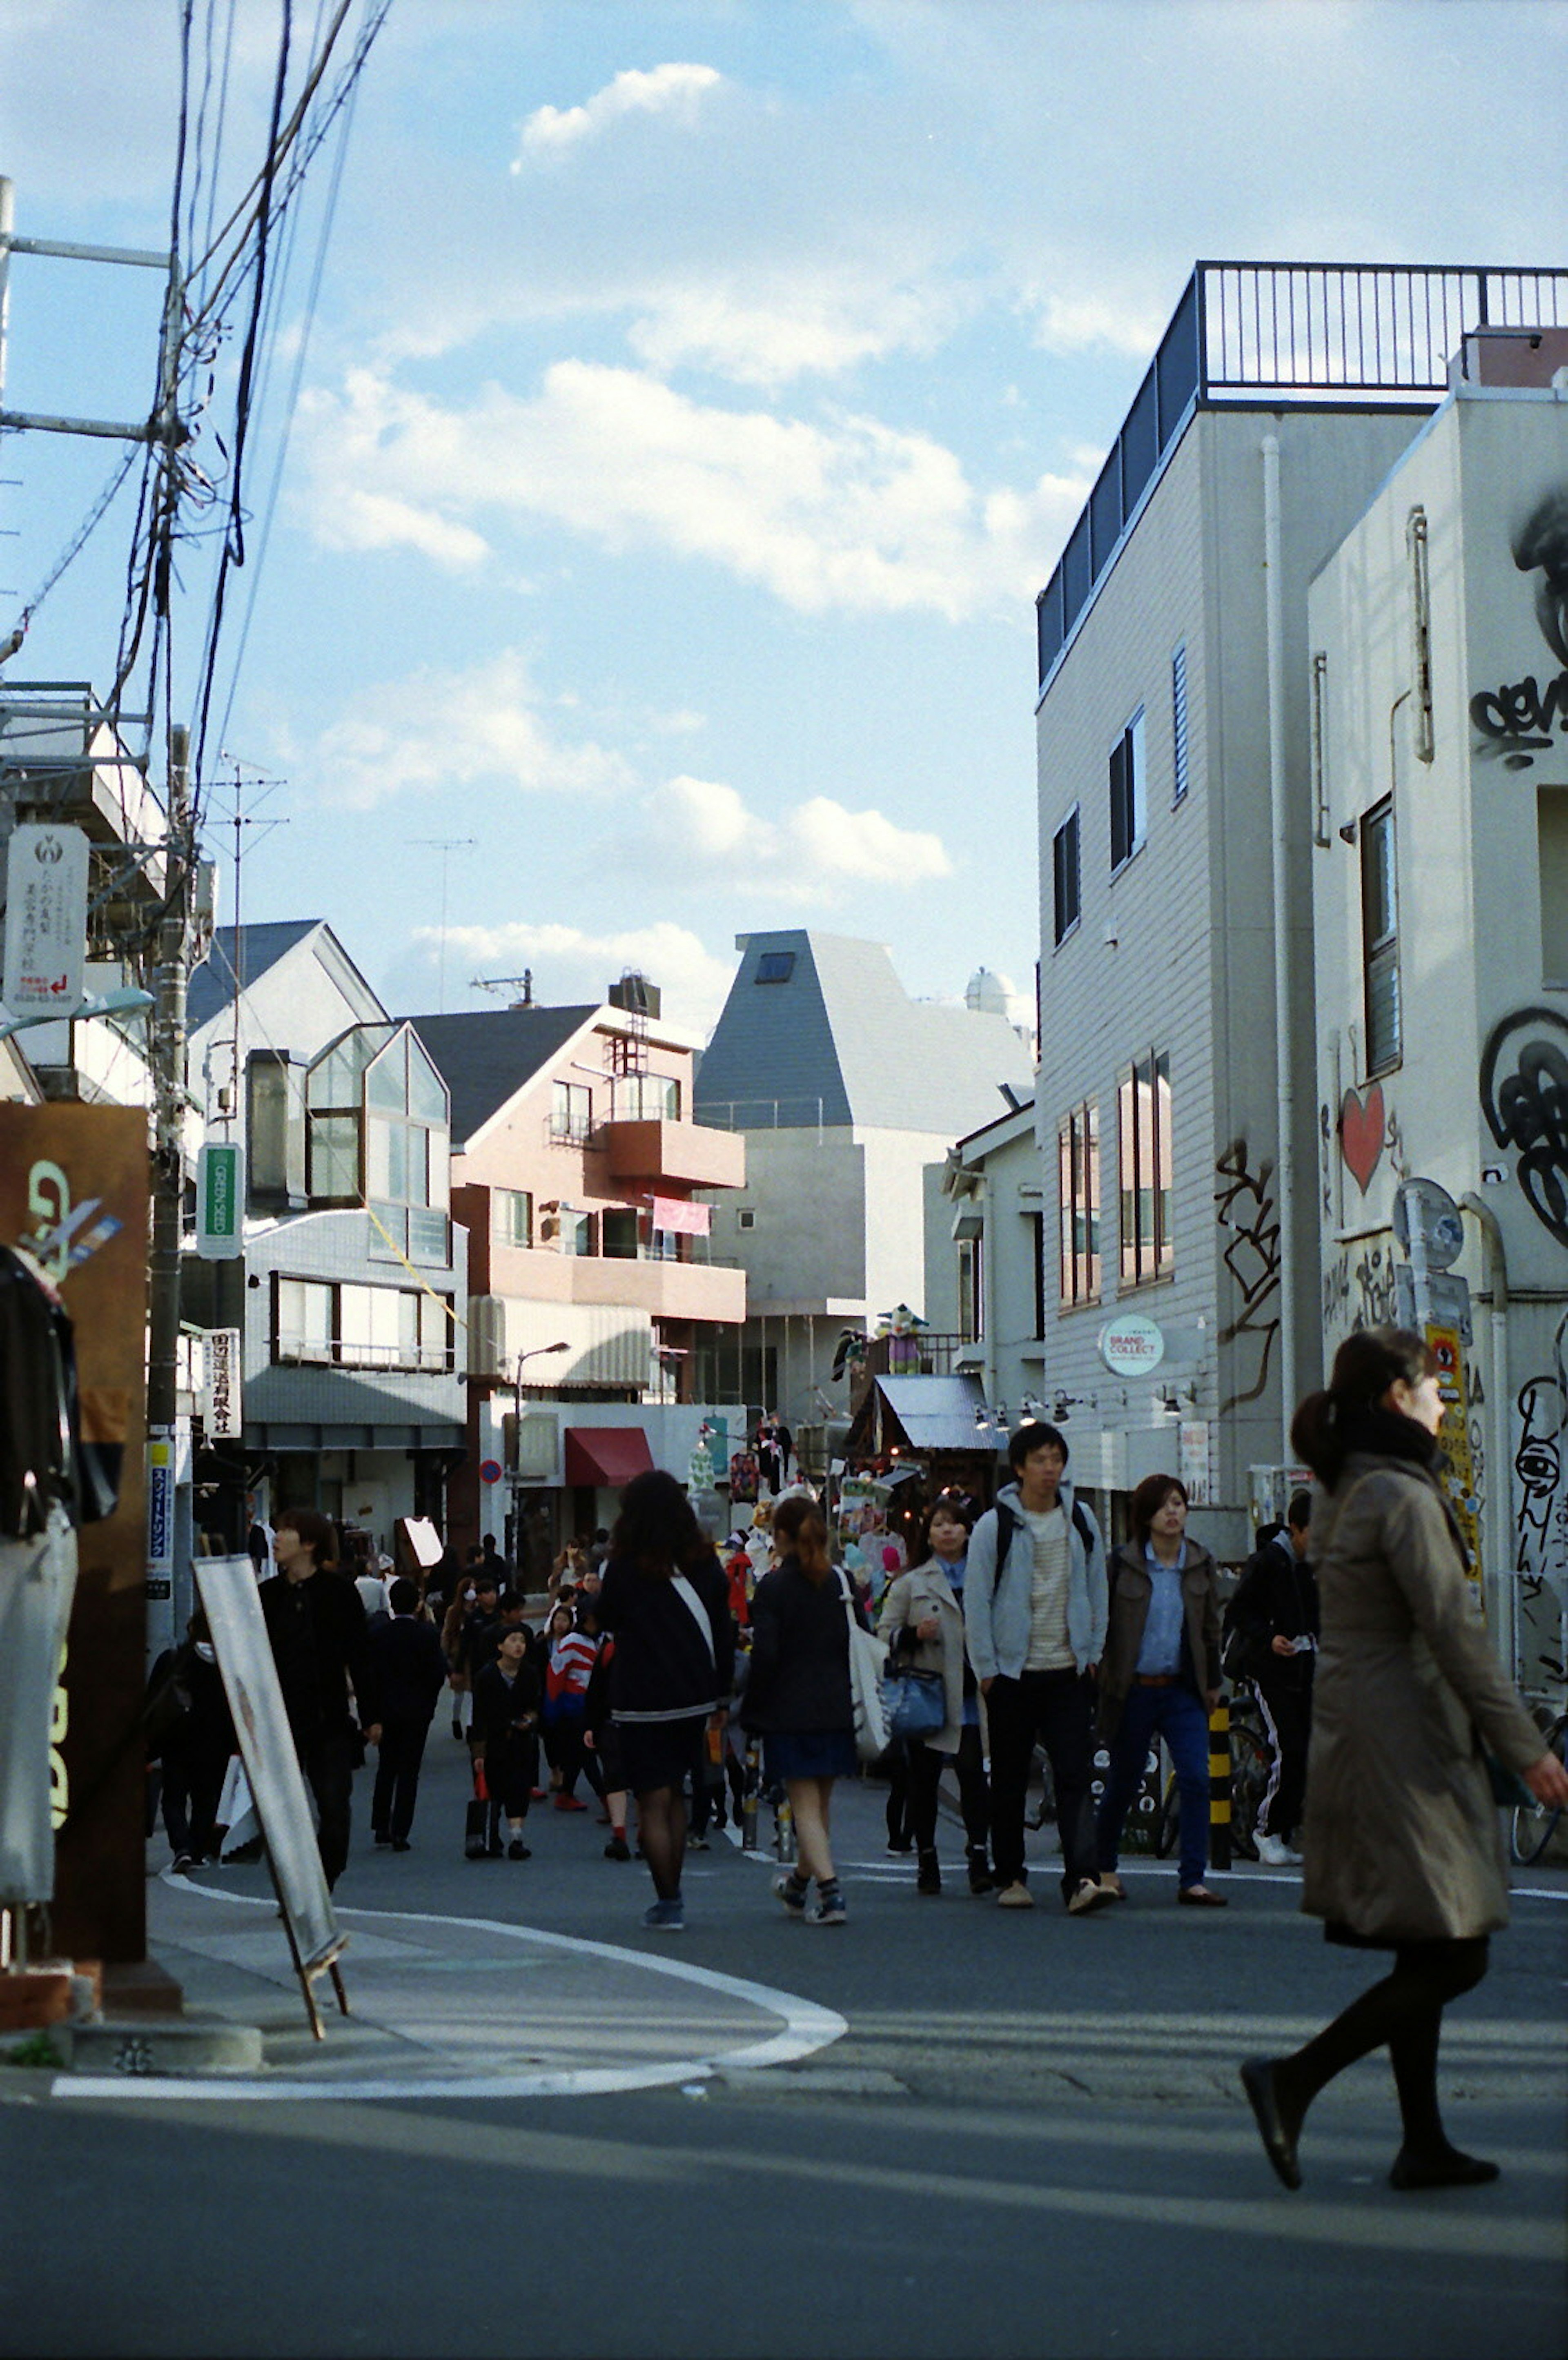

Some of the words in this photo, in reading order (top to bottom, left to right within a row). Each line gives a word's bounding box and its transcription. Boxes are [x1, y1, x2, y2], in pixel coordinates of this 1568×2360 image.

[214, 1165, 227, 1203] GREEN
[214, 1204, 226, 1234] SEED
[1109, 1345, 1155, 1354] COLLECT
[1110, 1336, 1145, 1345] BRAND
